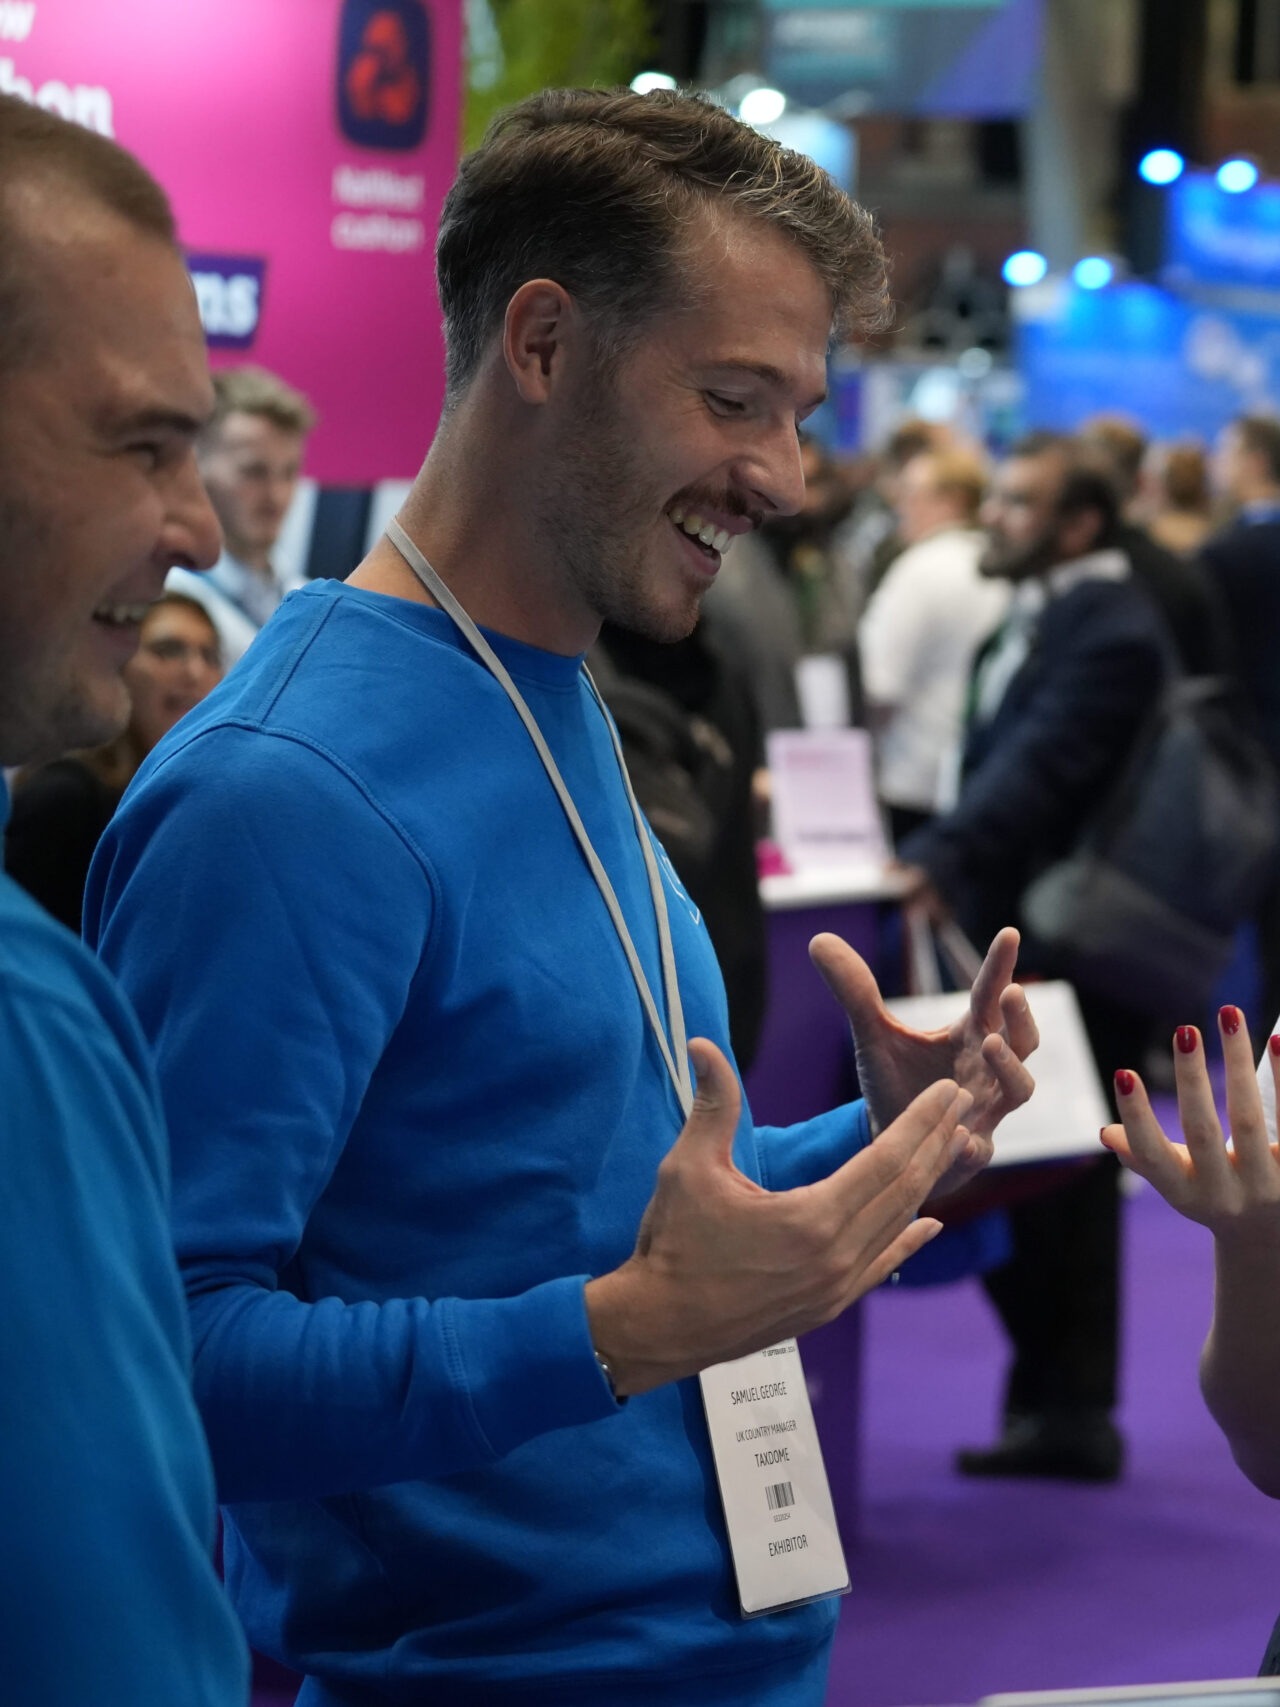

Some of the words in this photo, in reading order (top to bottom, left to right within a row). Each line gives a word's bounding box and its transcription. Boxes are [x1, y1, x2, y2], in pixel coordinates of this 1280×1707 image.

[731, 1387, 761, 1405] SAMUEL
[760, 1381, 787, 1399] GEORGE
[736, 1430, 746, 1442] UK
[745, 1425, 771, 1440] COUNTRY
[771, 1420, 797, 1434] MANAGER
[754, 1447, 790, 1467] TAXDOME
[768, 1534, 808, 1557] EXHIBITOR
